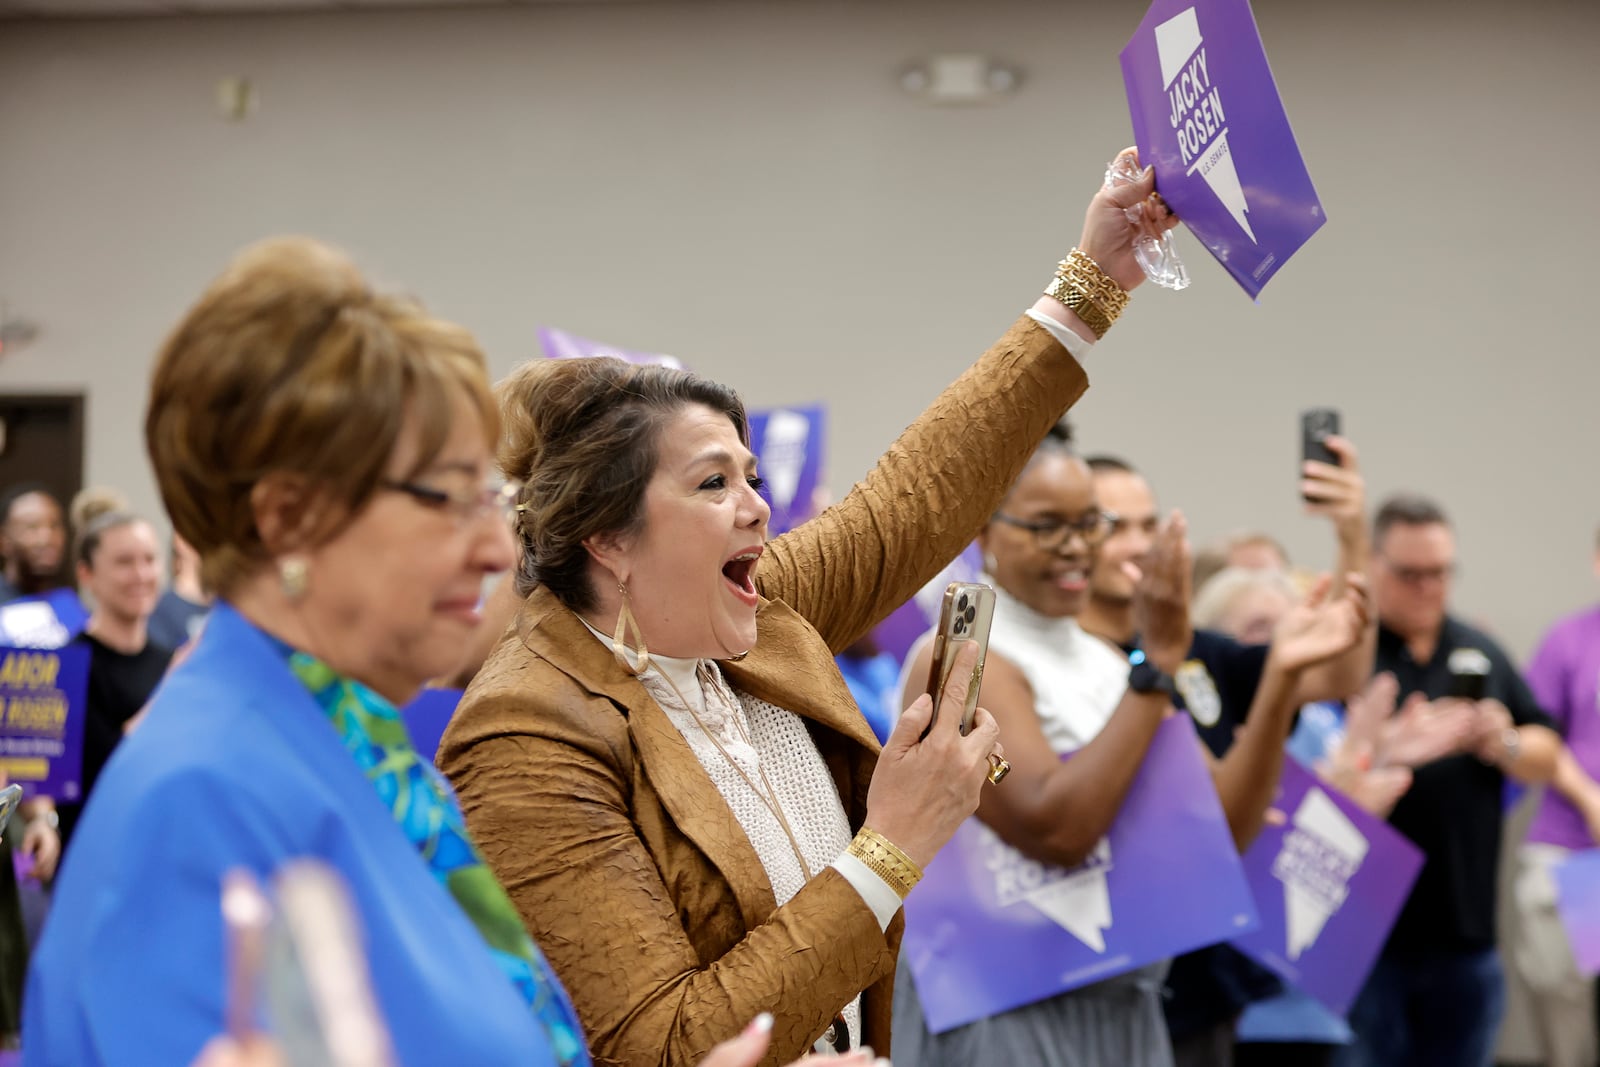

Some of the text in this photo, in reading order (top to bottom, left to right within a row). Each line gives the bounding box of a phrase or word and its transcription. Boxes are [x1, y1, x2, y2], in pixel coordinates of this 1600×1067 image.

[1169, 47, 1210, 129] JACKY
[1176, 86, 1226, 167] ROSEN
[0, 652, 60, 689] ABOR
